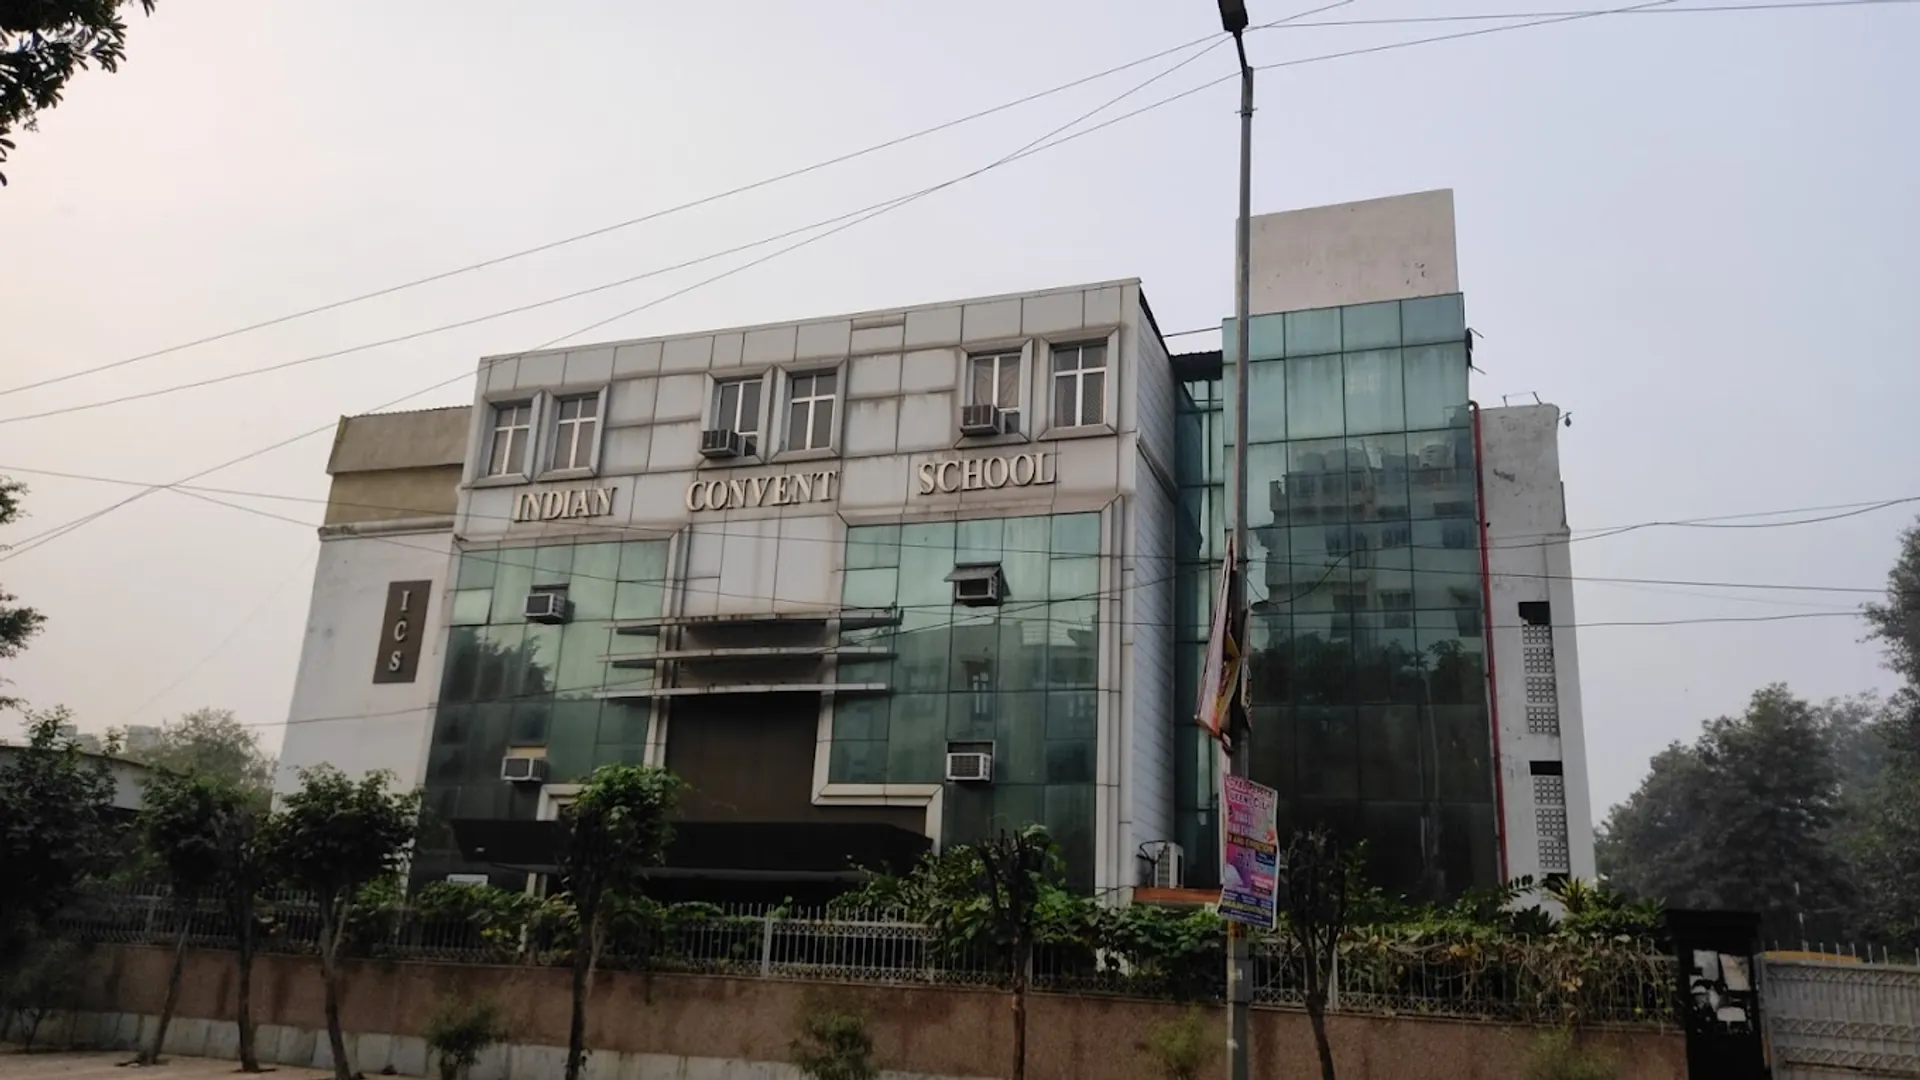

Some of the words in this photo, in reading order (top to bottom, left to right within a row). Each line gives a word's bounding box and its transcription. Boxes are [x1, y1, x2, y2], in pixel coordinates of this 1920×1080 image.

[513, 487, 616, 522] INDIAN
[686, 471, 838, 512] CONVENT
[918, 452, 1056, 495] SCHOOL
